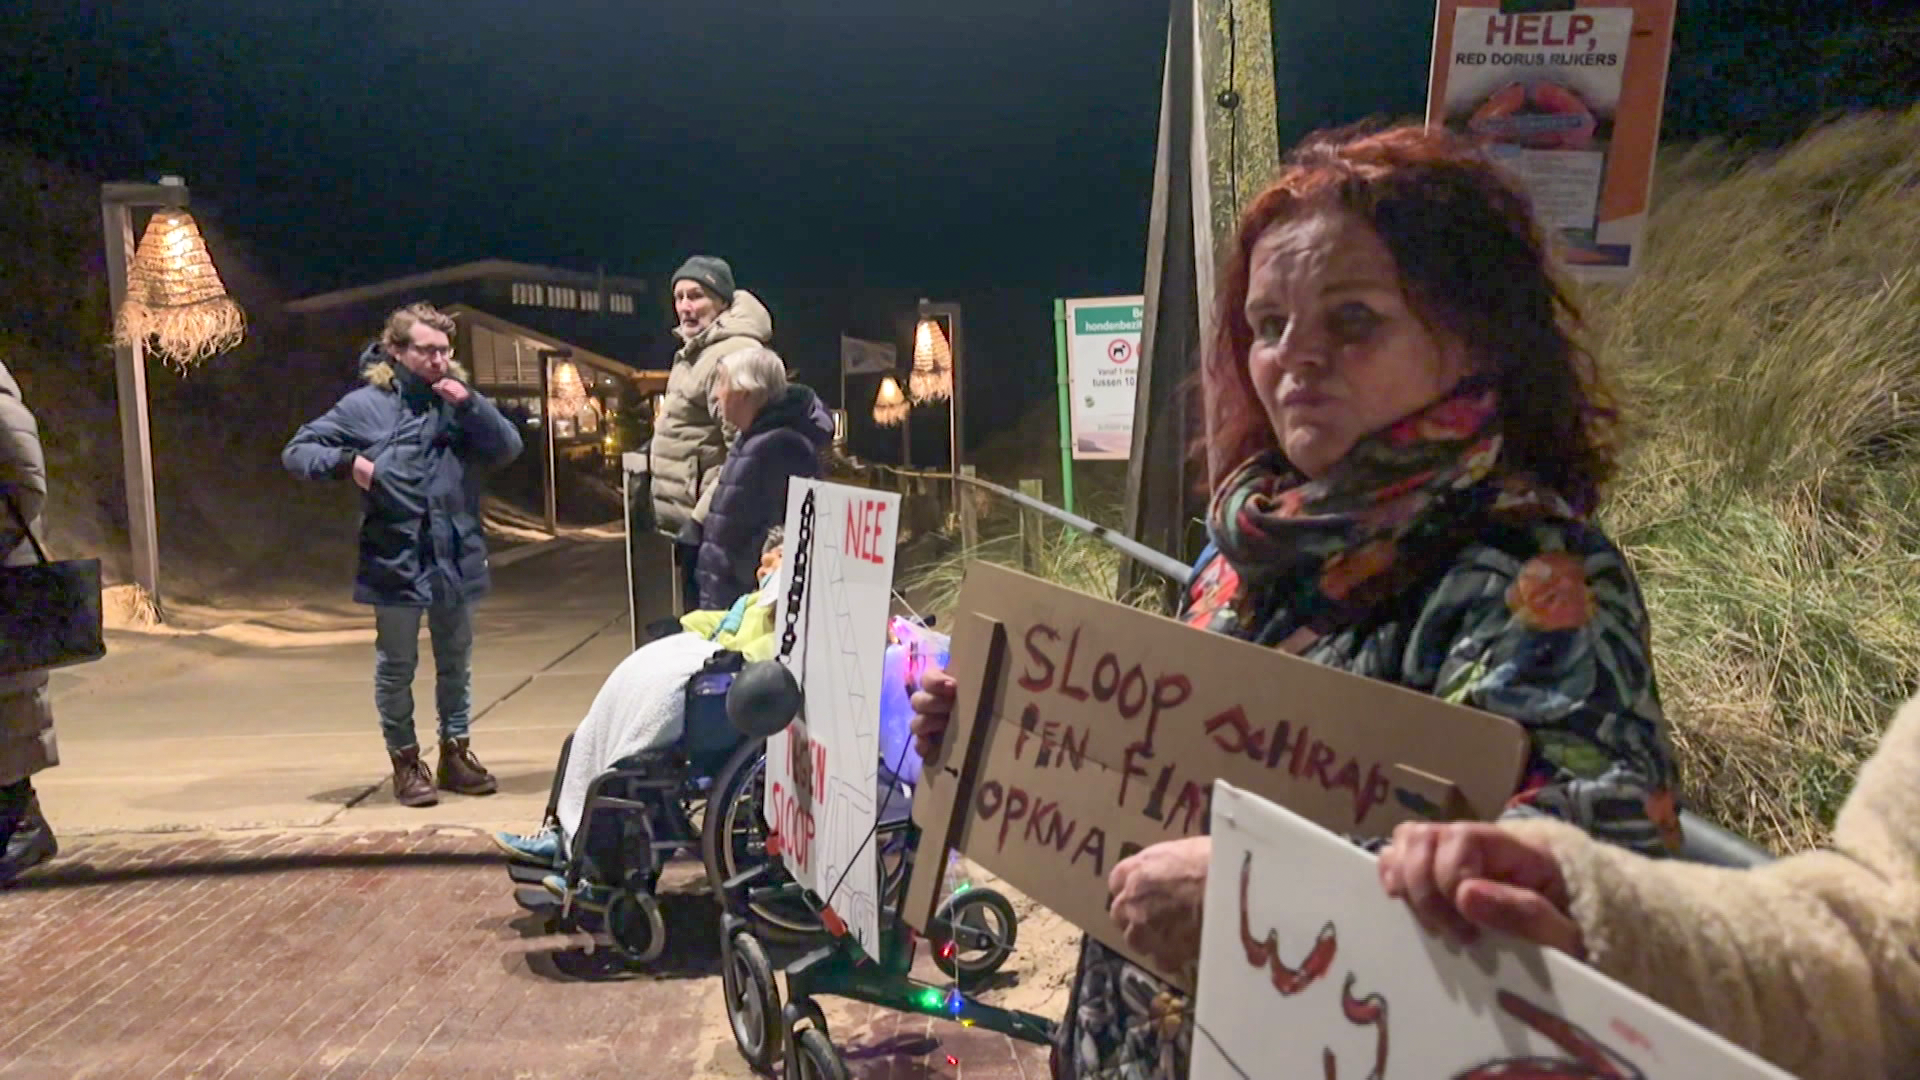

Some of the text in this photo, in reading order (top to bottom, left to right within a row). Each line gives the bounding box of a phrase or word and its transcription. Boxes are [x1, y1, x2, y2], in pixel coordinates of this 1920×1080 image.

[1455, 52, 1618, 66] RED DORUS RIJKERS
[1486, 14, 1597, 51] HELP,
[1093, 378, 1122, 387] tussen
[844, 496, 887, 565] NEE
[1018, 622, 1192, 758] SLOOP
[773, 781, 816, 875] SLOOP
